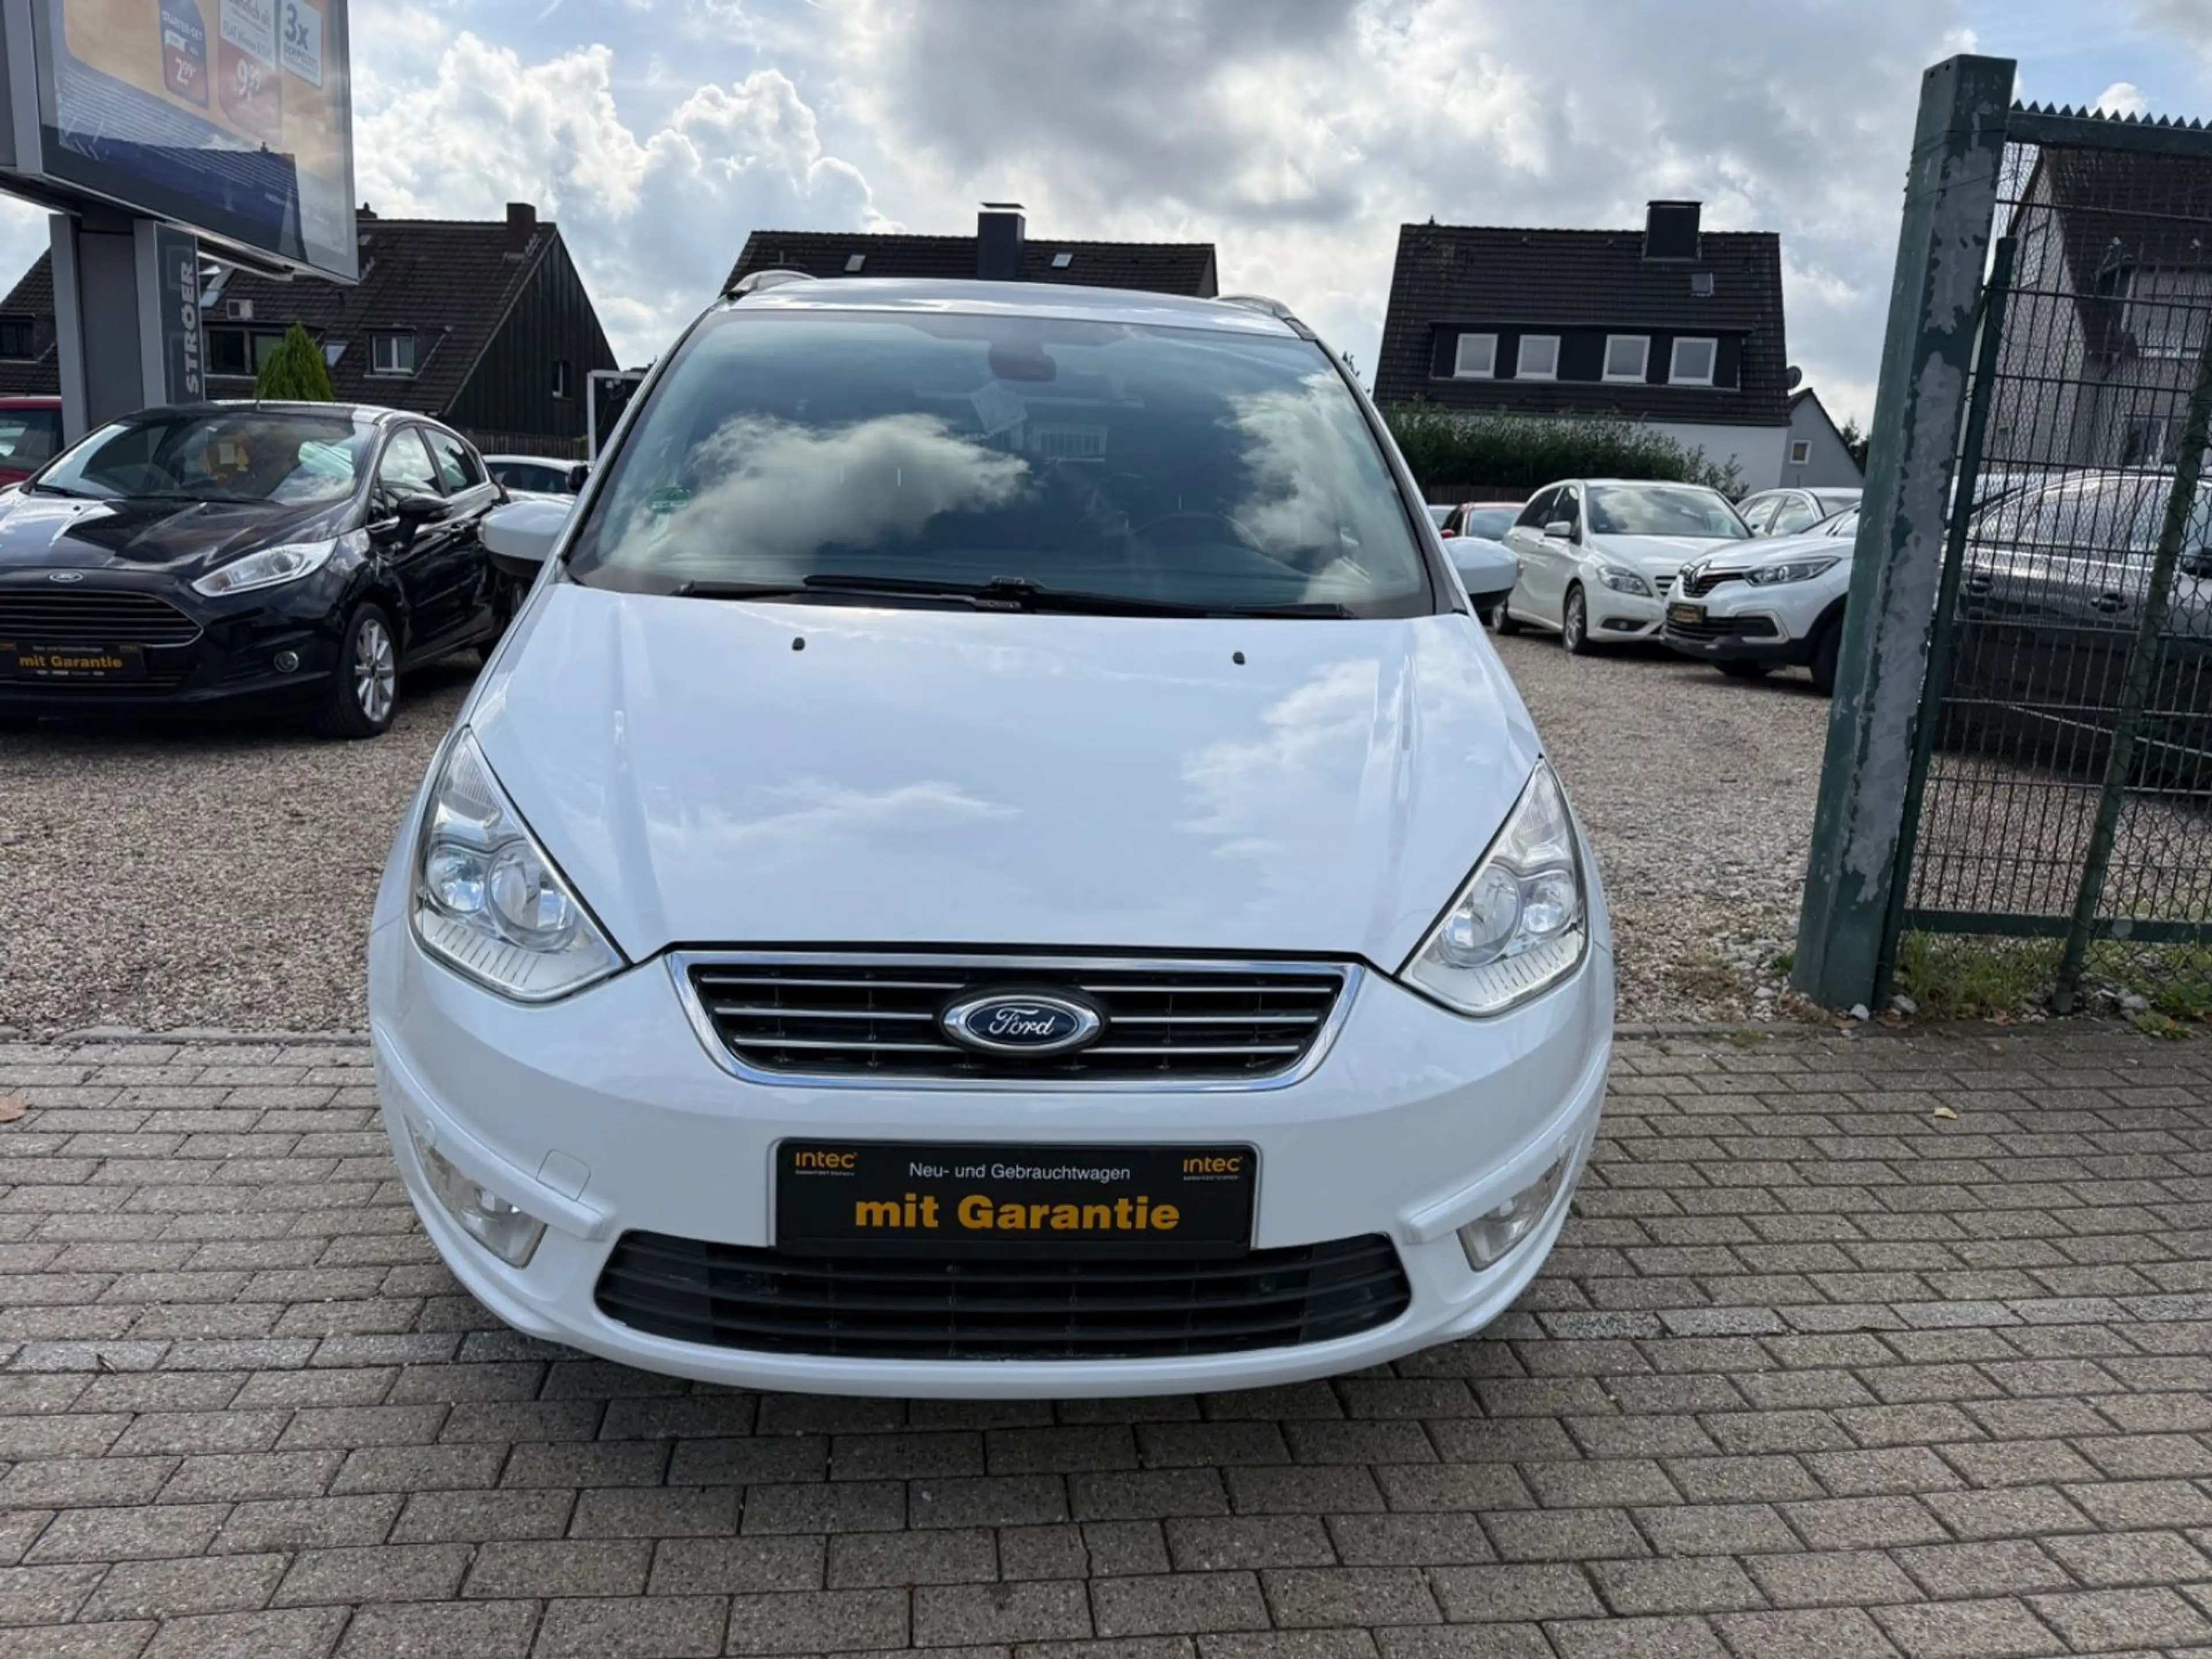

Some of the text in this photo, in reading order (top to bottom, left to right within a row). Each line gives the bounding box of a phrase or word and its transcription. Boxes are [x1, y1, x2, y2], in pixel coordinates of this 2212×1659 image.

[284, 3, 309, 50] 3x
[19, 654, 123, 669] mit Garantie
[988, 1008, 1056, 1035] Ford
[796, 1150, 856, 1169] intec
[1183, 1156, 1241, 1173] intec
[909, 1162, 1131, 1184] Neu- und Gebrauchtwagen
[855, 1192, 1180, 1230] mit Garantie
